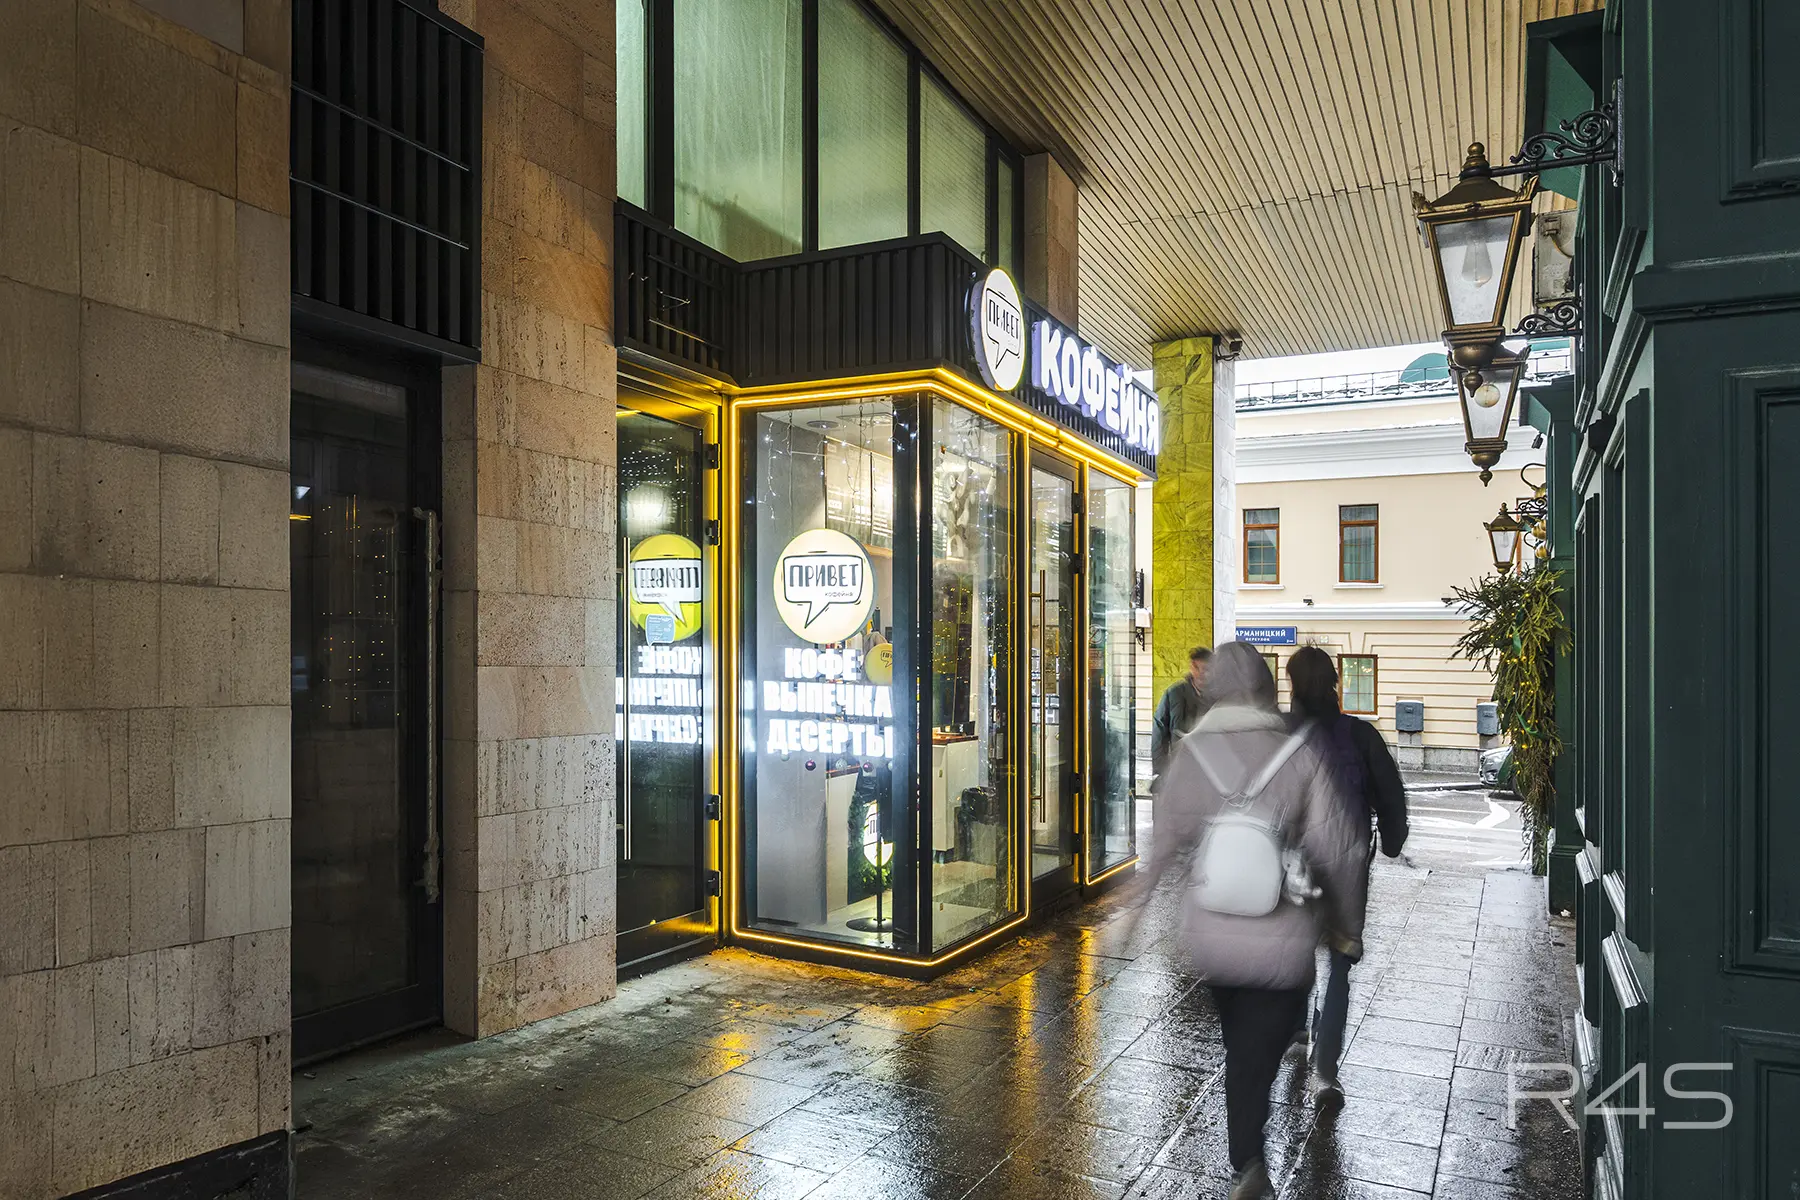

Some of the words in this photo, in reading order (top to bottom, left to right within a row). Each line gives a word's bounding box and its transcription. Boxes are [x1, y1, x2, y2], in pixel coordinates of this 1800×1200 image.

[1034, 320, 1160, 457] КОФЕЙНЯ
[789, 563, 859, 587] ПРИВЕТ
[1235, 629, 1286, 638] АРМАНИЦКИЙ
[784, 647, 858, 681] КОФЕ
[763, 680, 893, 718] ВЫПЕЧКА
[767, 719, 893, 758] ДЕСЕРТЫ
